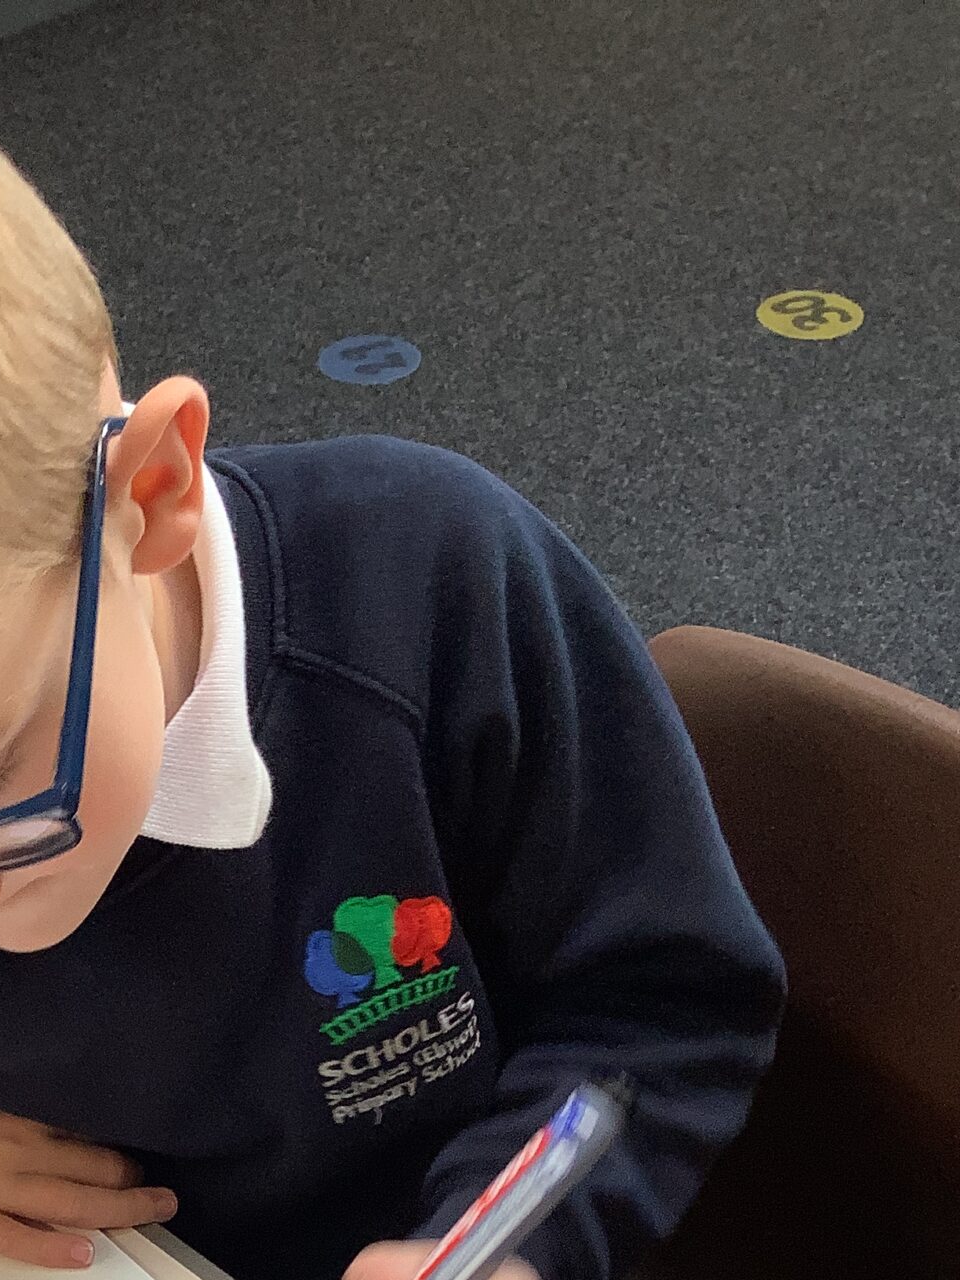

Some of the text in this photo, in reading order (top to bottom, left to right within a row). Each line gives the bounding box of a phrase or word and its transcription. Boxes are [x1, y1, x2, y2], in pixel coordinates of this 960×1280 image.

[771, 296, 853, 331] 30
[317, 991, 475, 1088] SCHOLES
[421, 1029, 481, 1083] School
[324, 1061, 411, 1106] Scholes
